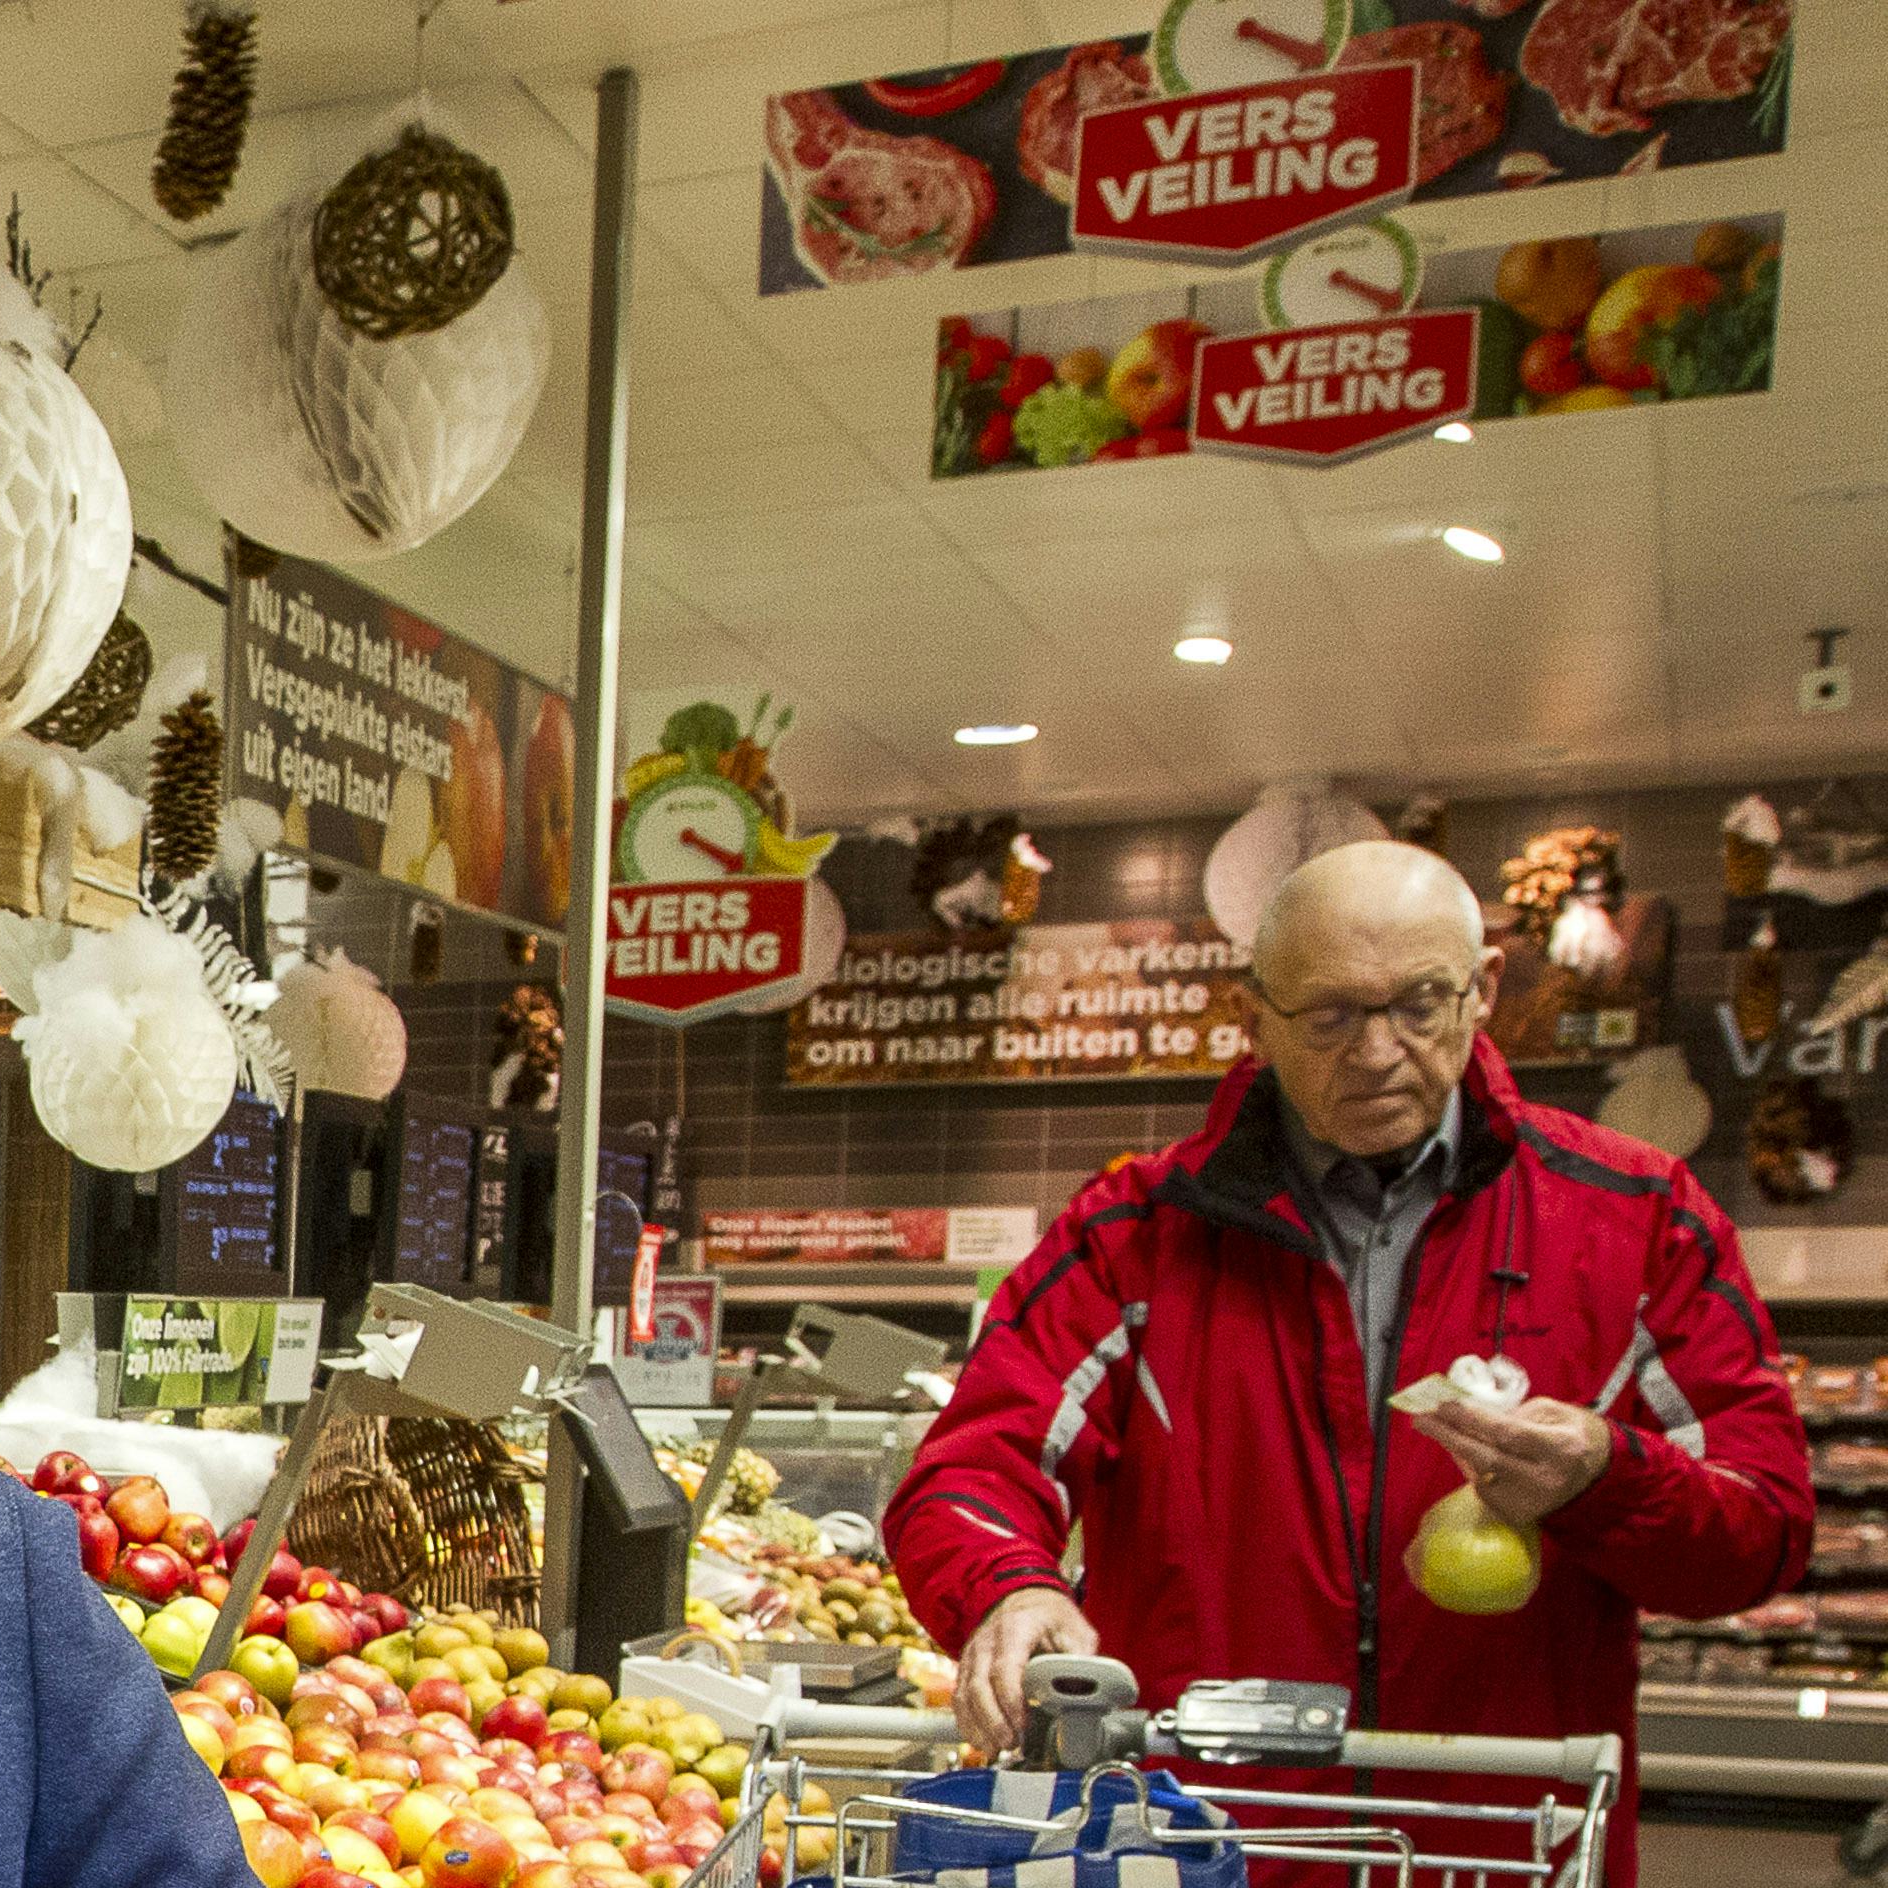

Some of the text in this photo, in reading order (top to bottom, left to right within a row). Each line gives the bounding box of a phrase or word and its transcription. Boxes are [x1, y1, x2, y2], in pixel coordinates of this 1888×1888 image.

[1144, 87, 1339, 163] VERS
[1096, 146, 1380, 226] VEILING
[1251, 327, 1412, 384] VERS
[1212, 367, 1446, 433] VEILING
[248, 578, 282, 635] Nu
[285, 591, 326, 661] zijn
[330, 619, 355, 669] ze
[358, 621, 392, 689] het
[243, 720, 274, 782] uit
[279, 735, 340, 807] eigen
[391, 712, 453, 782] elstars
[610, 891, 750, 934] VERS
[808, 979, 1209, 1031] krijgen alle ruimte
[808, 1020, 1196, 1066] om naar buiten te
[131, 1314, 162, 1340] Onze
[128, 1348, 181, 1380] zijn 100%
